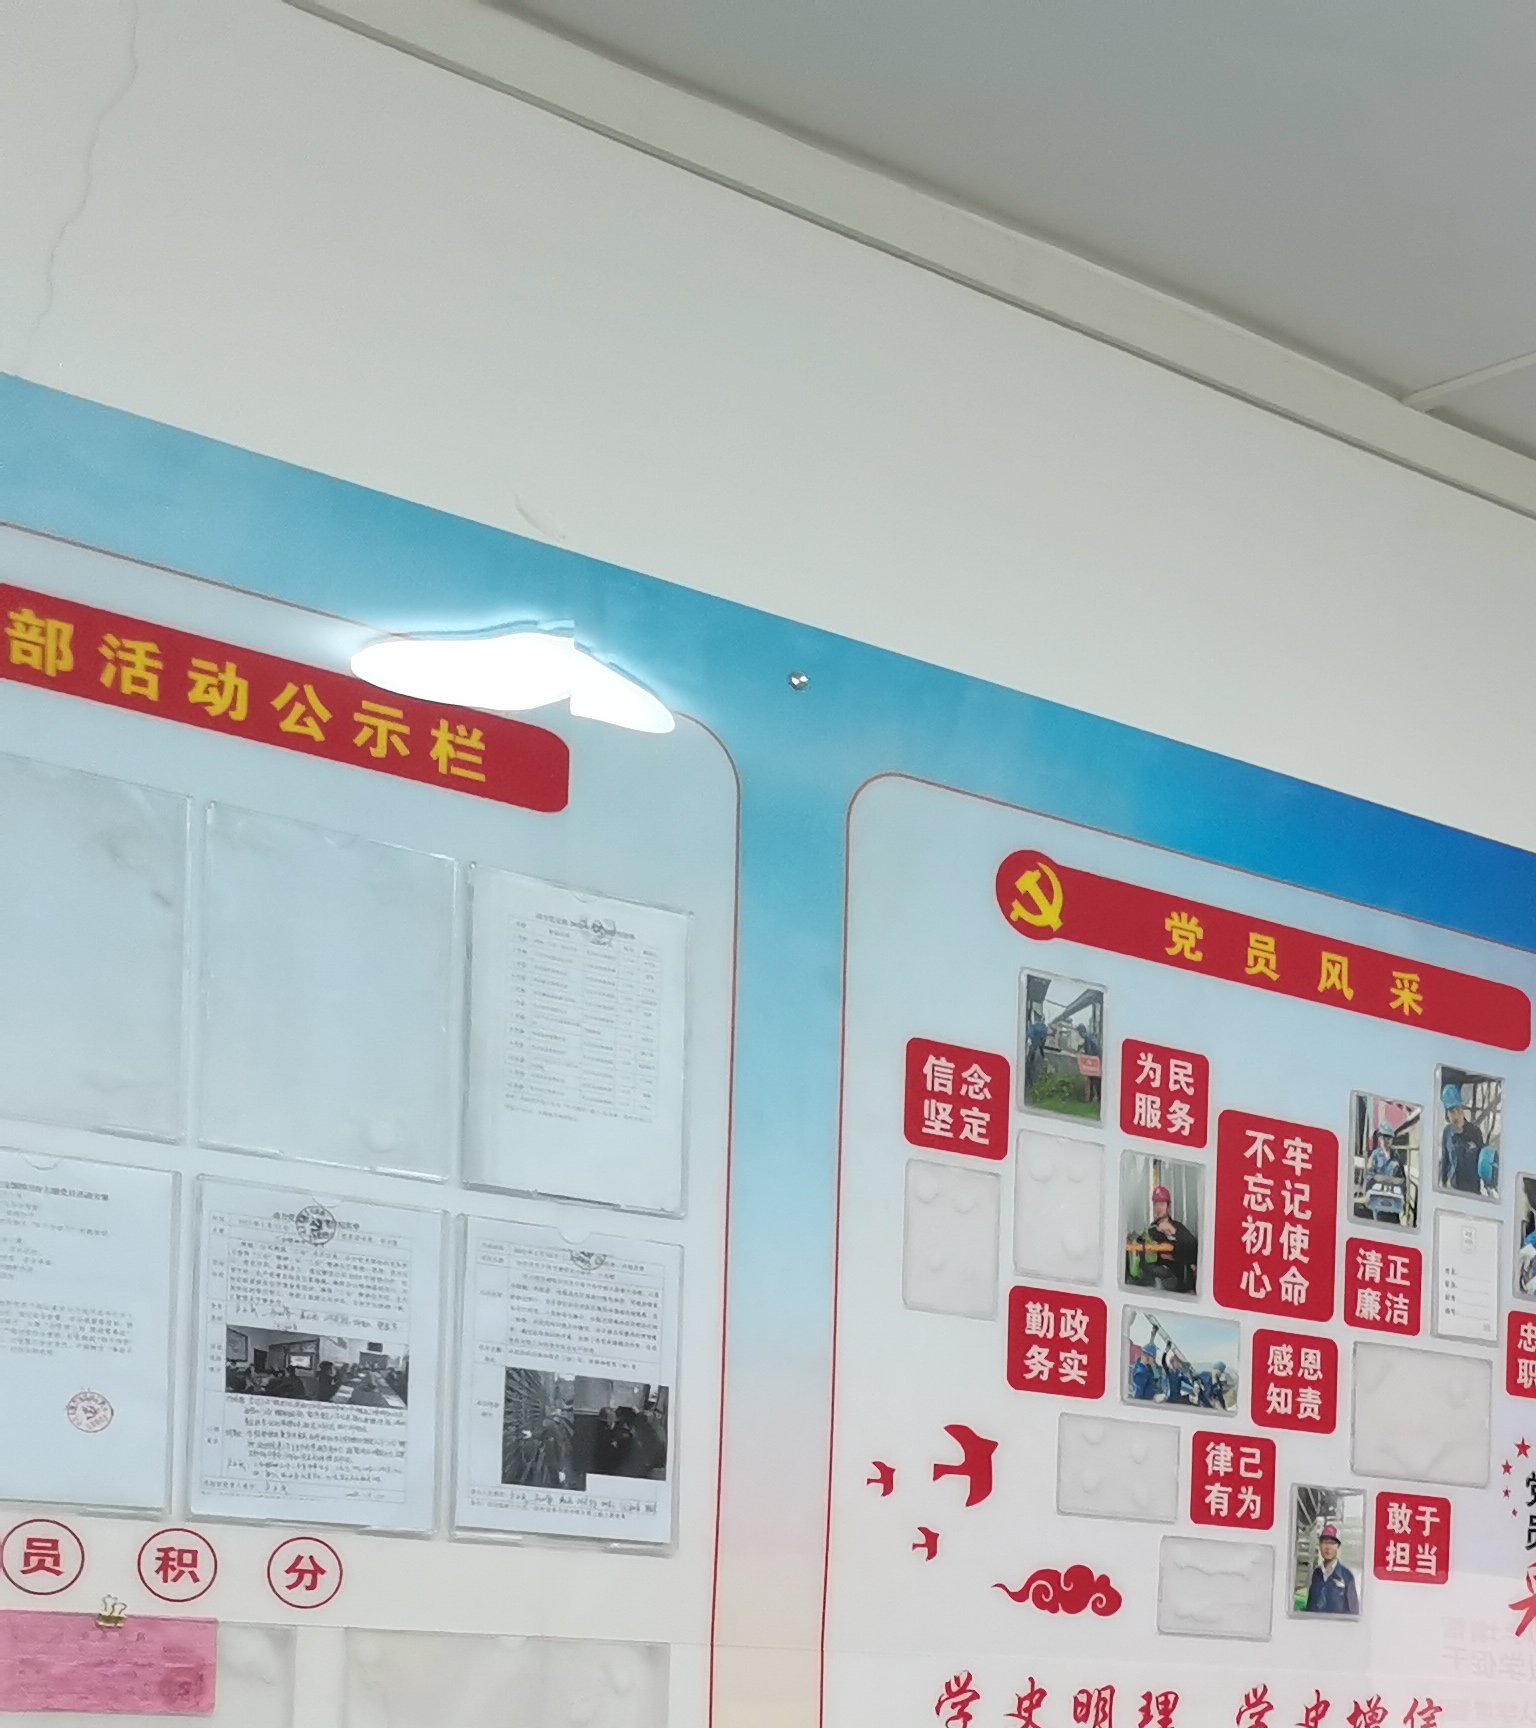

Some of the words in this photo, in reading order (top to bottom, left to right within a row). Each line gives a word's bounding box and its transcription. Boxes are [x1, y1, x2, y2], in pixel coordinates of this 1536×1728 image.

[5, 608, 487, 782] 部活动公示栏
[1165, 913, 1424, 1015] 党员风采
[922, 1053, 991, 1102] 信念
[1134, 1052, 1196, 1097] 为民
[920, 1097, 991, 1146] 坚定
[1133, 1094, 1194, 1136] 服务
[1241, 1130, 1276, 1299] 不忘初心
[1279, 1137, 1313, 1306] 牢记使命
[1355, 1247, 1411, 1288] 清正
[1024, 1300, 1091, 1344] 勤政
[1354, 1287, 1410, 1329] 廉洁
[1023, 1341, 1088, 1387] 务实
[1266, 1343, 1323, 1382] 感恩
[1265, 1382, 1323, 1422] 知责
[1205, 1441, 1264, 1479] 律己
[1204, 1482, 1262, 1520] 有为
[1386, 1502, 1441, 1537] 敢于
[1385, 1540, 1439, 1577] 担当
